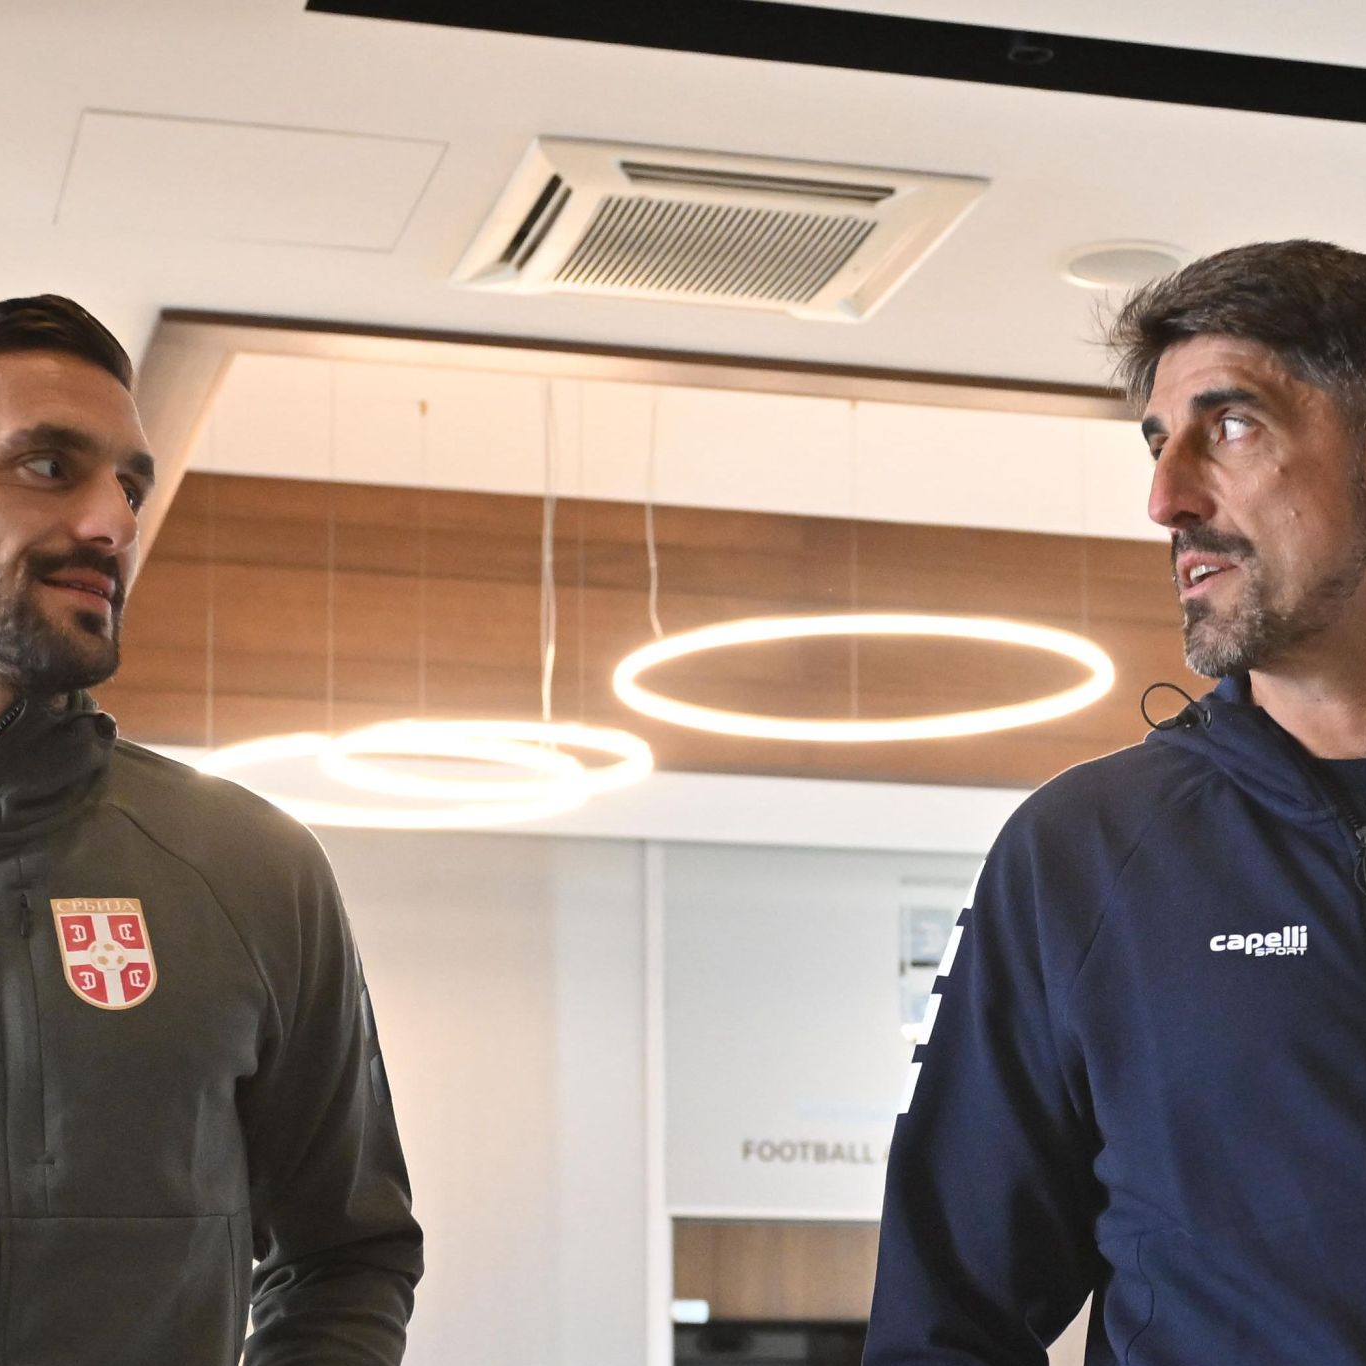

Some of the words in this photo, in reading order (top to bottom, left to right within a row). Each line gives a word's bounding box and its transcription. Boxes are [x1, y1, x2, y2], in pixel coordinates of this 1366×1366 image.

[56, 900, 136, 912] СРБИЈА
[1209, 925, 1308, 955] capelli
[1255, 946, 1307, 957] SPORT
[741, 1139, 873, 1164] FOOTBALL
